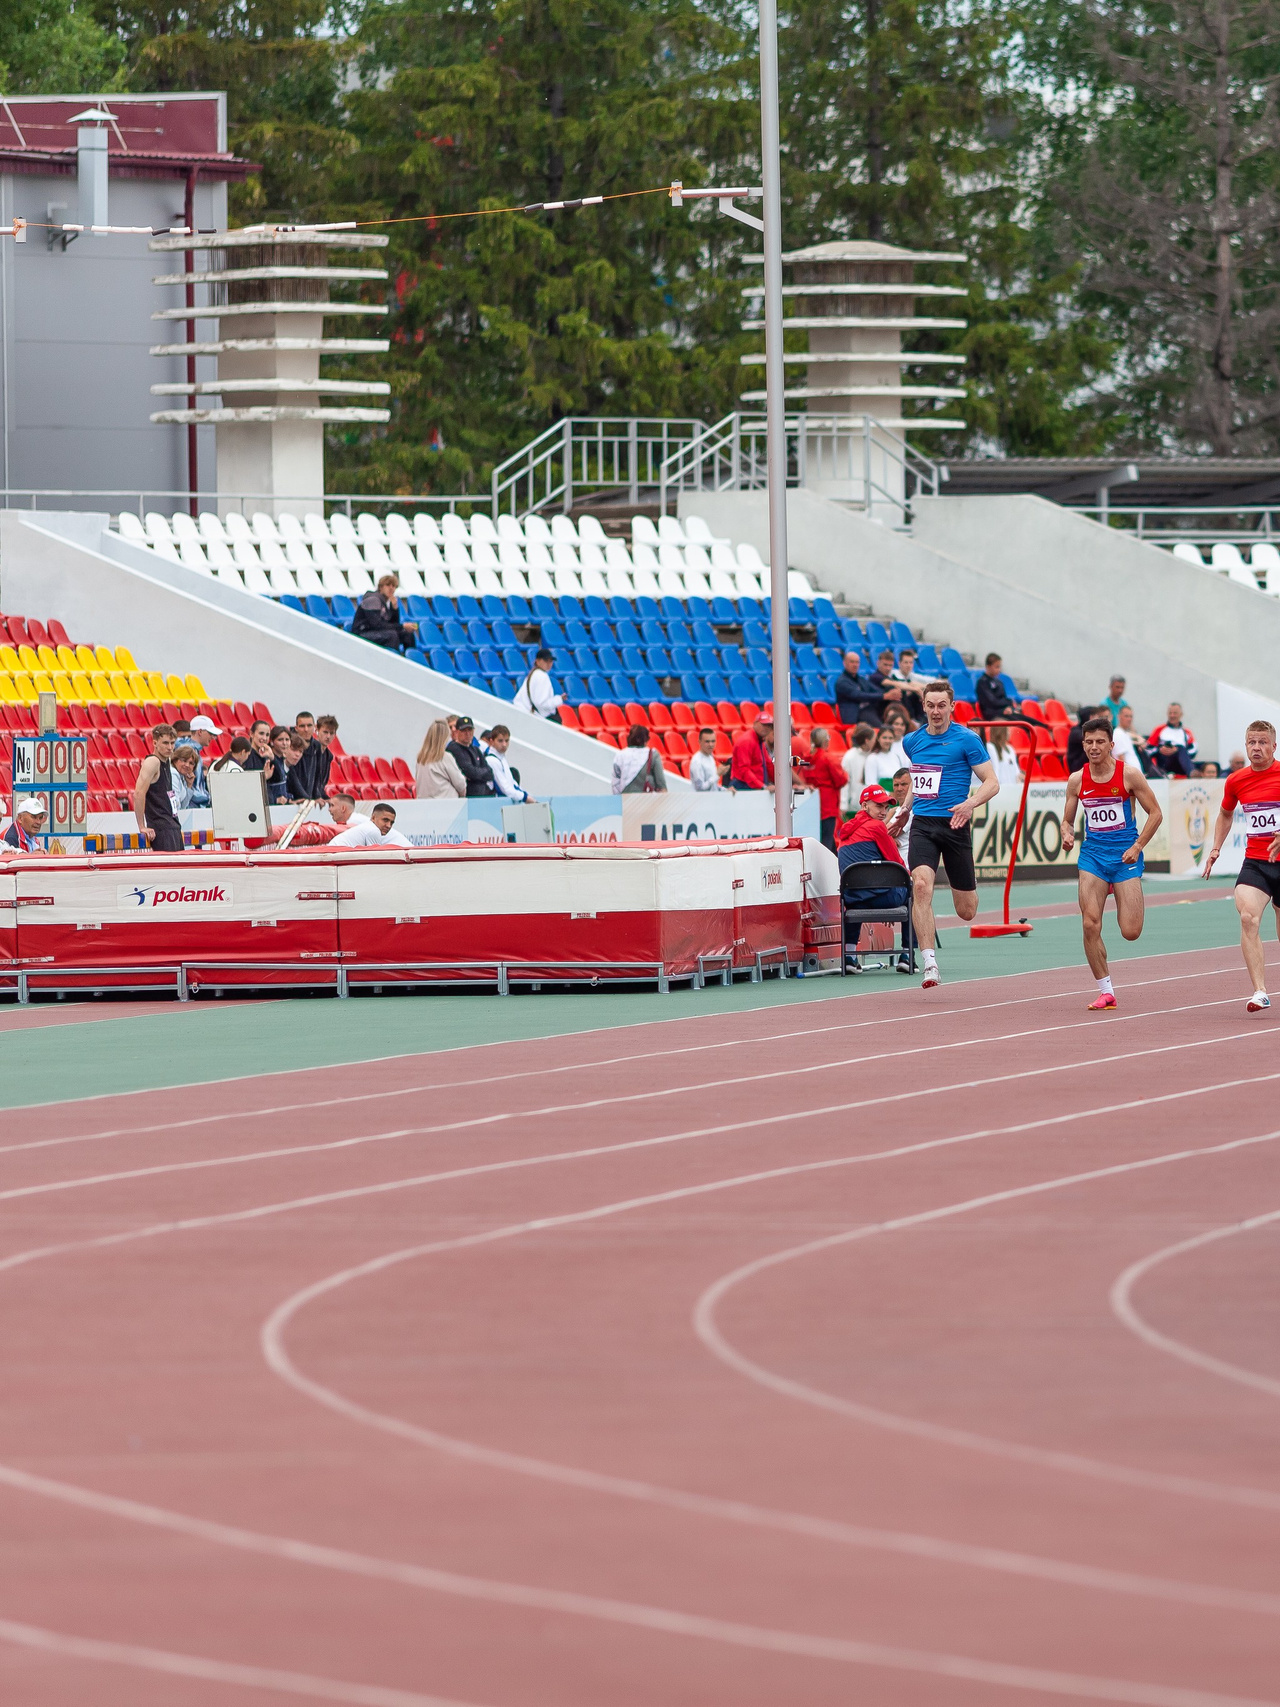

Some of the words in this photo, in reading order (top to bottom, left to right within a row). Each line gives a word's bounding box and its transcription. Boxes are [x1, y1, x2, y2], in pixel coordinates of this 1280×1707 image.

[913, 776, 933, 790] 194
[1091, 809, 1117, 823] 400
[1250, 814, 1277, 828] 204
[152, 885, 227, 907] polanik
